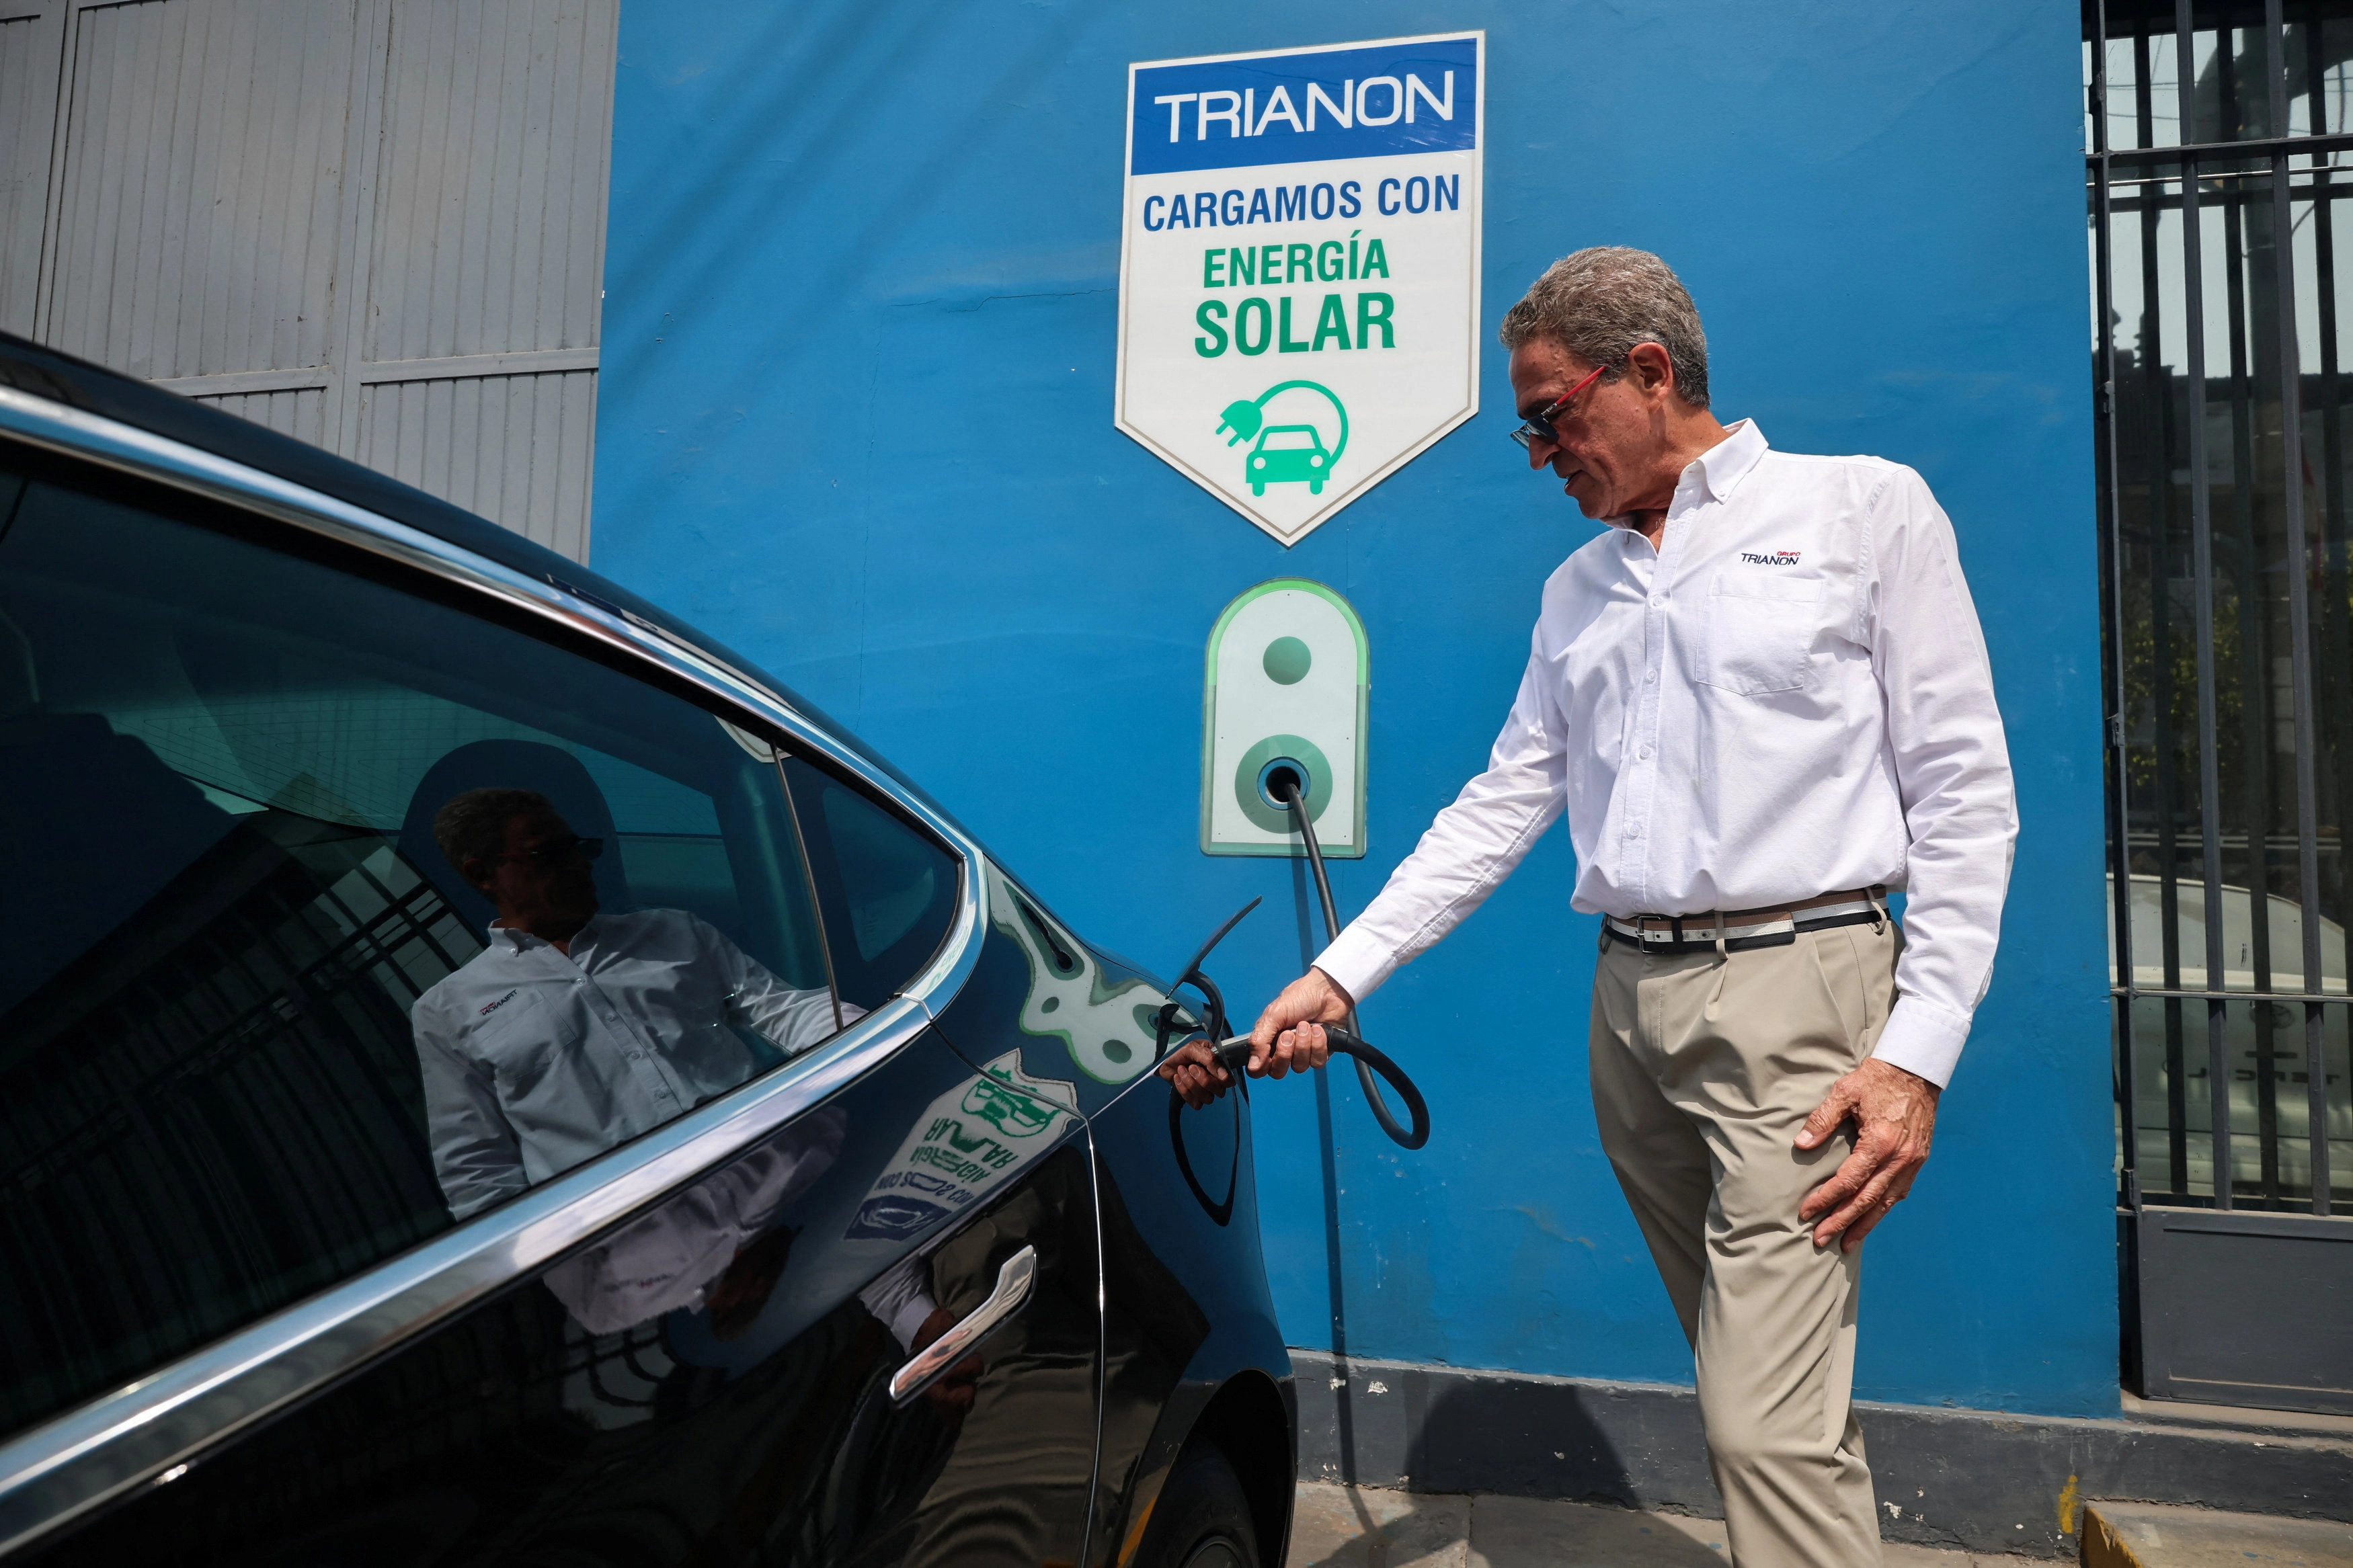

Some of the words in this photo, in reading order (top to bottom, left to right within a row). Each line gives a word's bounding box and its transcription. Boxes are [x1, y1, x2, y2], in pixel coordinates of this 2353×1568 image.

[1154, 70, 1454, 143] TRIANON
[1143, 180, 1362, 233] CARGAMOS
[1377, 173, 1460, 216] CON
[1203, 229, 1390, 289] ENERGÍA
[1194, 292, 1396, 359] SOLAR
[1741, 552, 1799, 566] TRIANON
